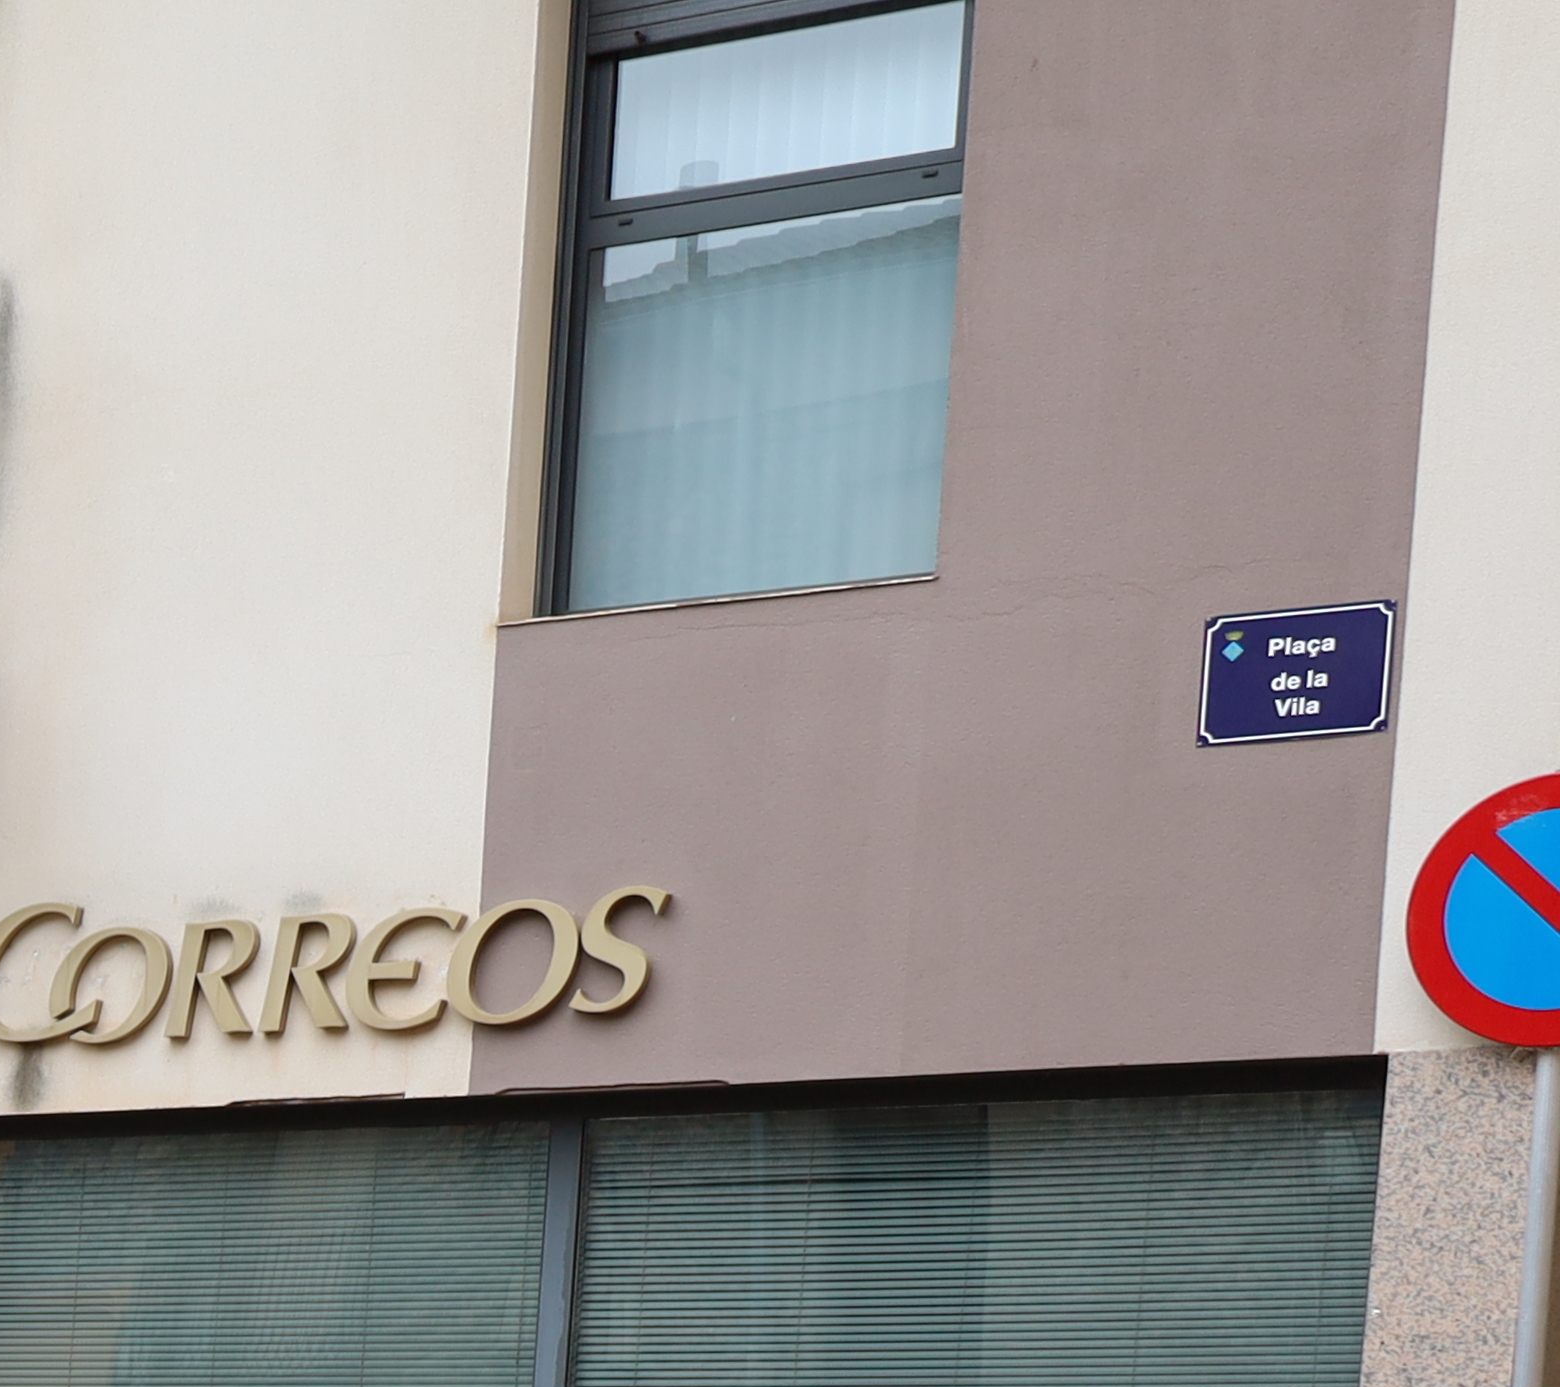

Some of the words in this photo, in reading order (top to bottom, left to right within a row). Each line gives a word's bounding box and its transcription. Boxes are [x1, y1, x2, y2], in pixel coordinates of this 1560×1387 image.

[1267, 636, 1337, 658] Plaça
[1270, 671, 1301, 691] de
[1306, 669, 1329, 688] la
[1274, 696, 1320, 717] Vila
